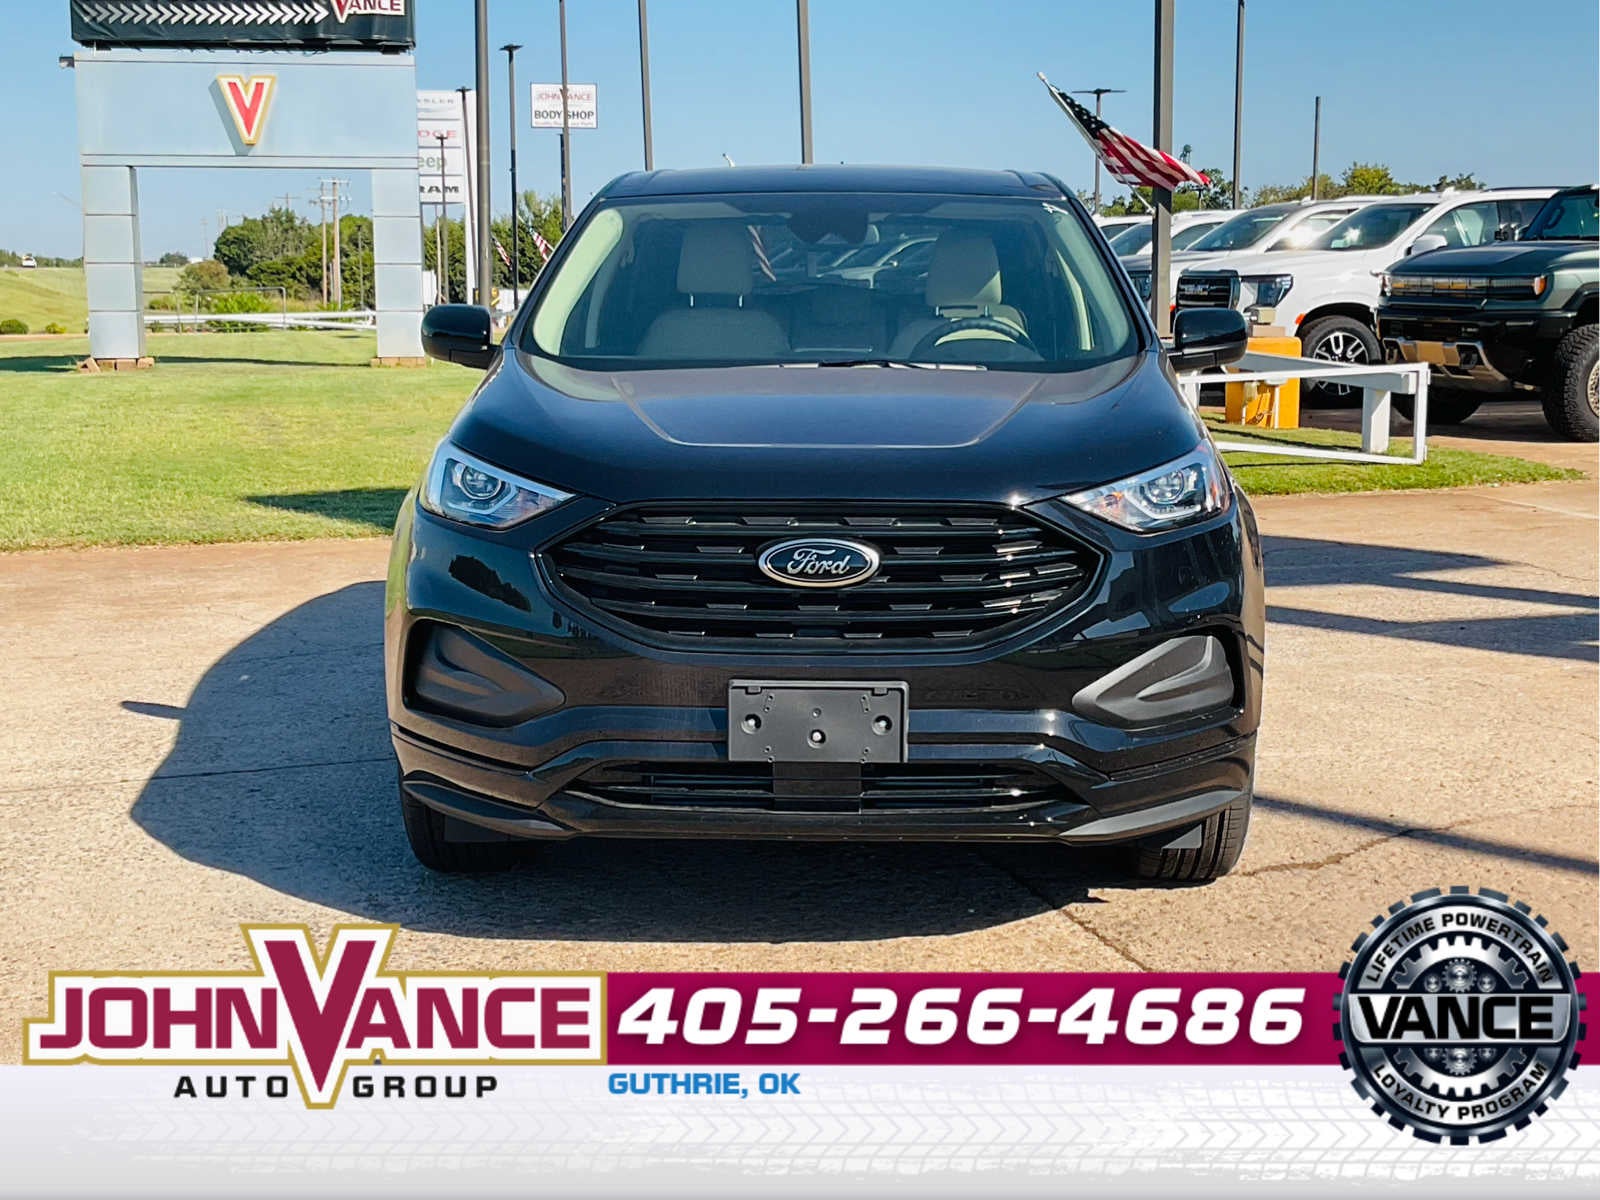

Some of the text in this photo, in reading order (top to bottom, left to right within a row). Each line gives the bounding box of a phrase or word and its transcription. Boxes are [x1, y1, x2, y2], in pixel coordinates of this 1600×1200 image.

[218, 76, 274, 143] V
[534, 110, 594, 119] BODY SHOP
[418, 156, 447, 172] eep
[786, 548, 851, 575] Ford
